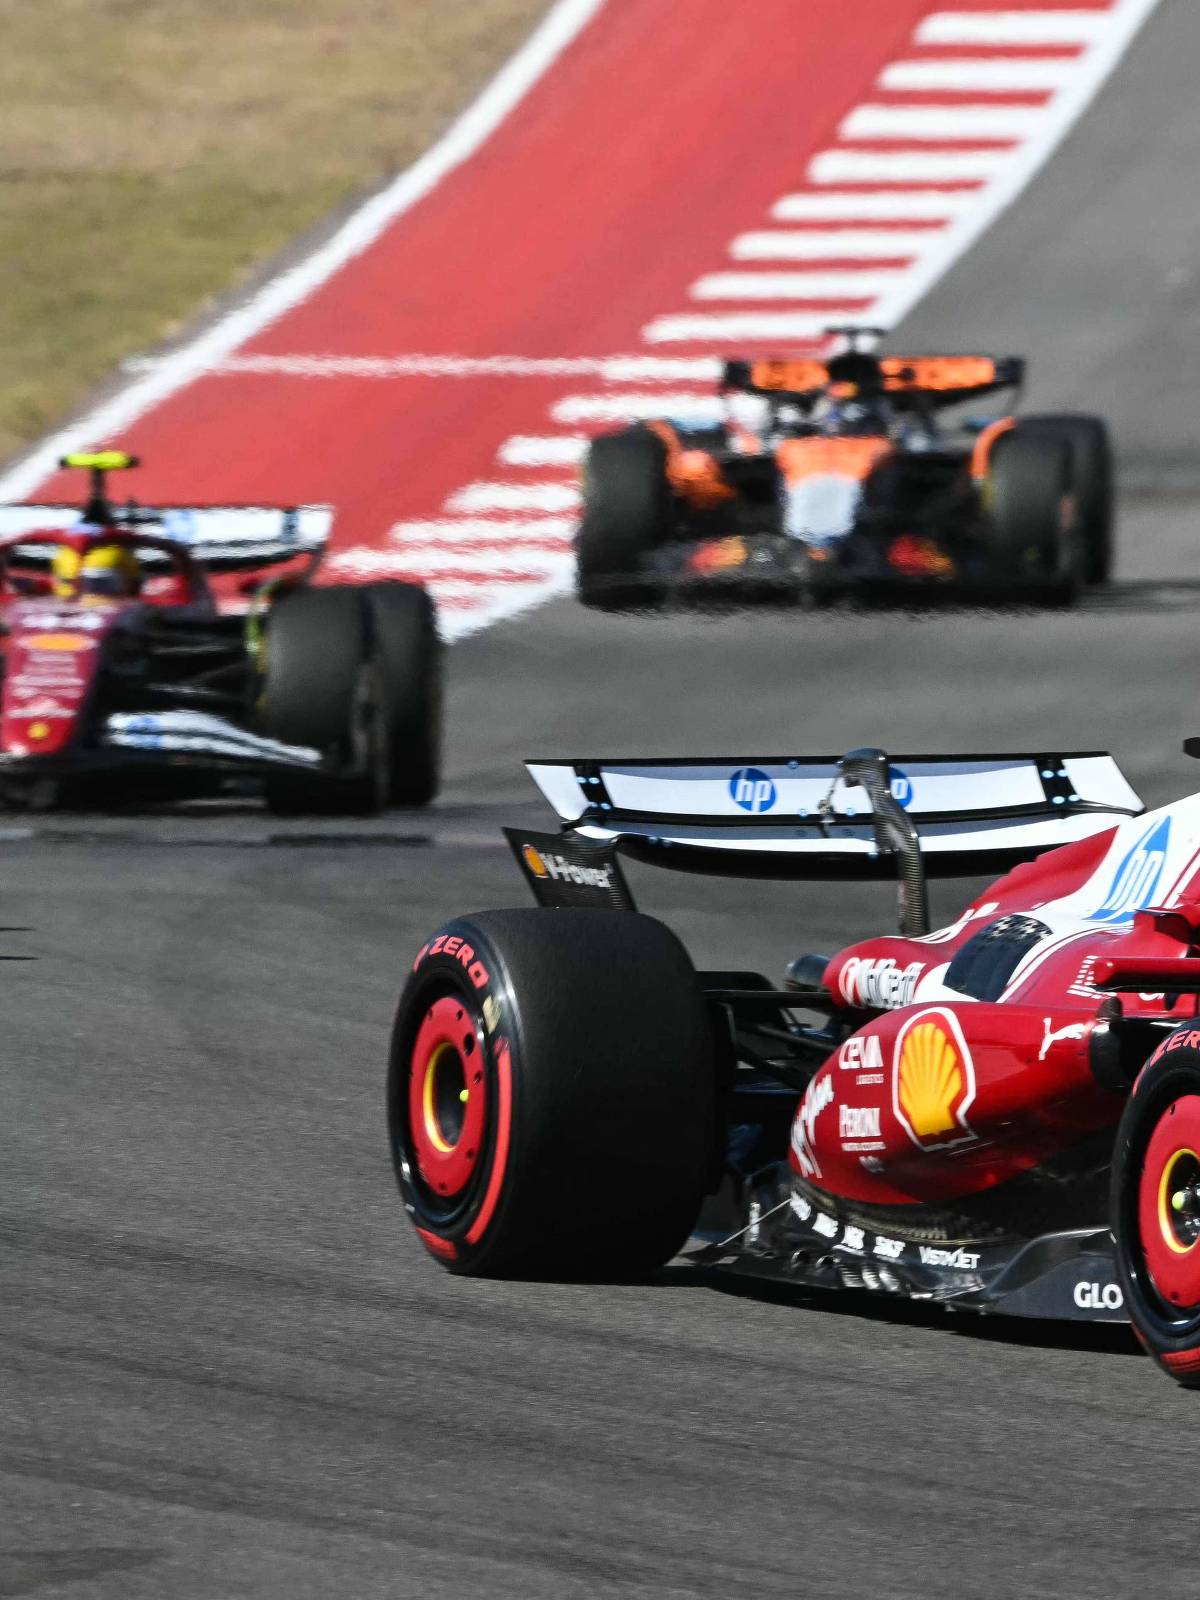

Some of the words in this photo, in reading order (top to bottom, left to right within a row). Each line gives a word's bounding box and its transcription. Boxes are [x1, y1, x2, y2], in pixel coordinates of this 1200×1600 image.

[732, 768, 774, 812] hp
[429, 935, 489, 989] ZERO
[1074, 1281, 1124, 1309] GLO
